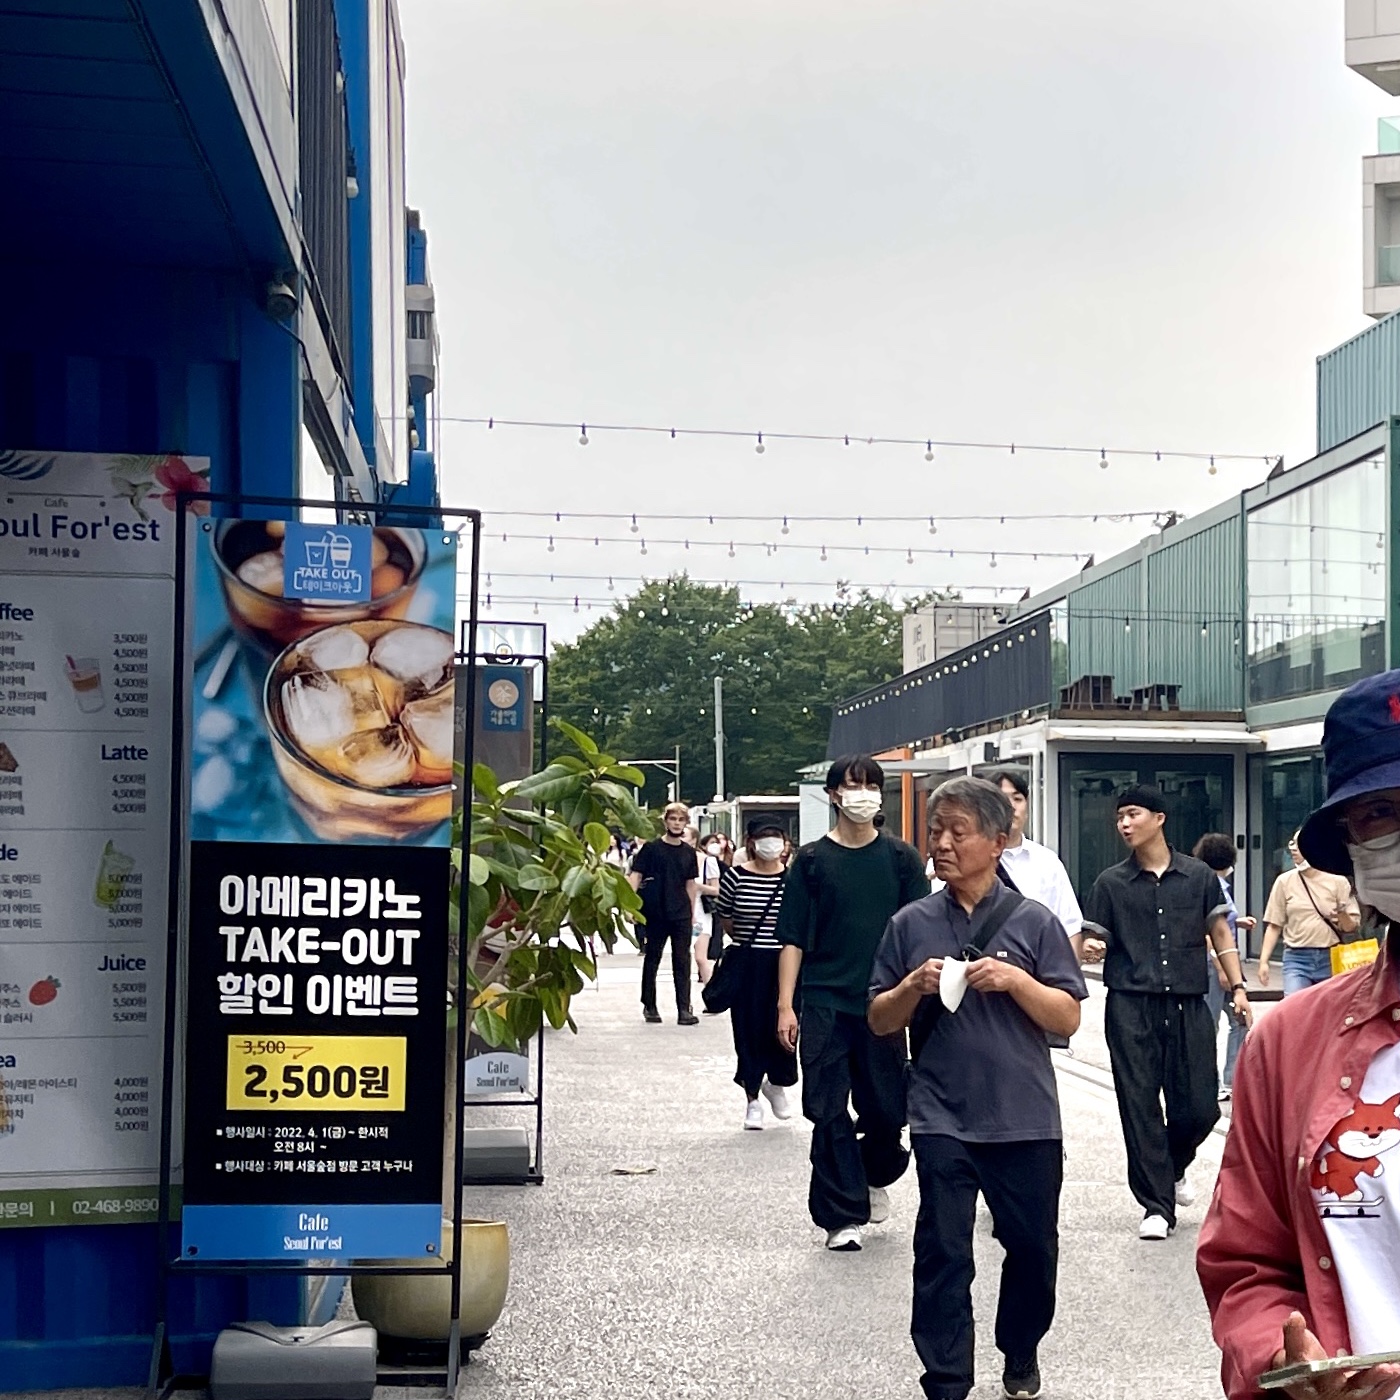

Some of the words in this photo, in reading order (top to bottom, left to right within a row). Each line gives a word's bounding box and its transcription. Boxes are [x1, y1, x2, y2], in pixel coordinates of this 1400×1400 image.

[44, 498, 69, 508] Cafe
[51, 514, 160, 542] For'est
[299, 567, 329, 579] TAKE
[331, 568, 357, 580] OUT
[302, 580, 353, 594] 테이크아웃
[101, 744, 148, 761] Latte
[219, 875, 422, 919] 아메리카노
[219, 926, 421, 966] TAKE-OUT
[97, 953, 147, 971] Juice
[217, 972, 293, 1015] 할인
[306, 974, 419, 1016] 이벤트
[243, 1040, 286, 1056] 3,500
[38, 1078, 77, 1089] 아이스티
[244, 1064, 389, 1104] 2,500원
[358, 1126, 389, 1139] 한시적
[273, 1141, 295, 1153] 오전
[296, 1141, 315, 1153] 8시
[273, 1160, 294, 1172] 카페
[296, 1160, 336, 1172] 서울숲점
[338, 1160, 358, 1172] 방문
[360, 1160, 381, 1172] 고객
[383, 1160, 413, 1172] 누구나
[72, 1198, 159, 1215] 02-468-9890
[299, 1213, 329, 1231] Cafe
